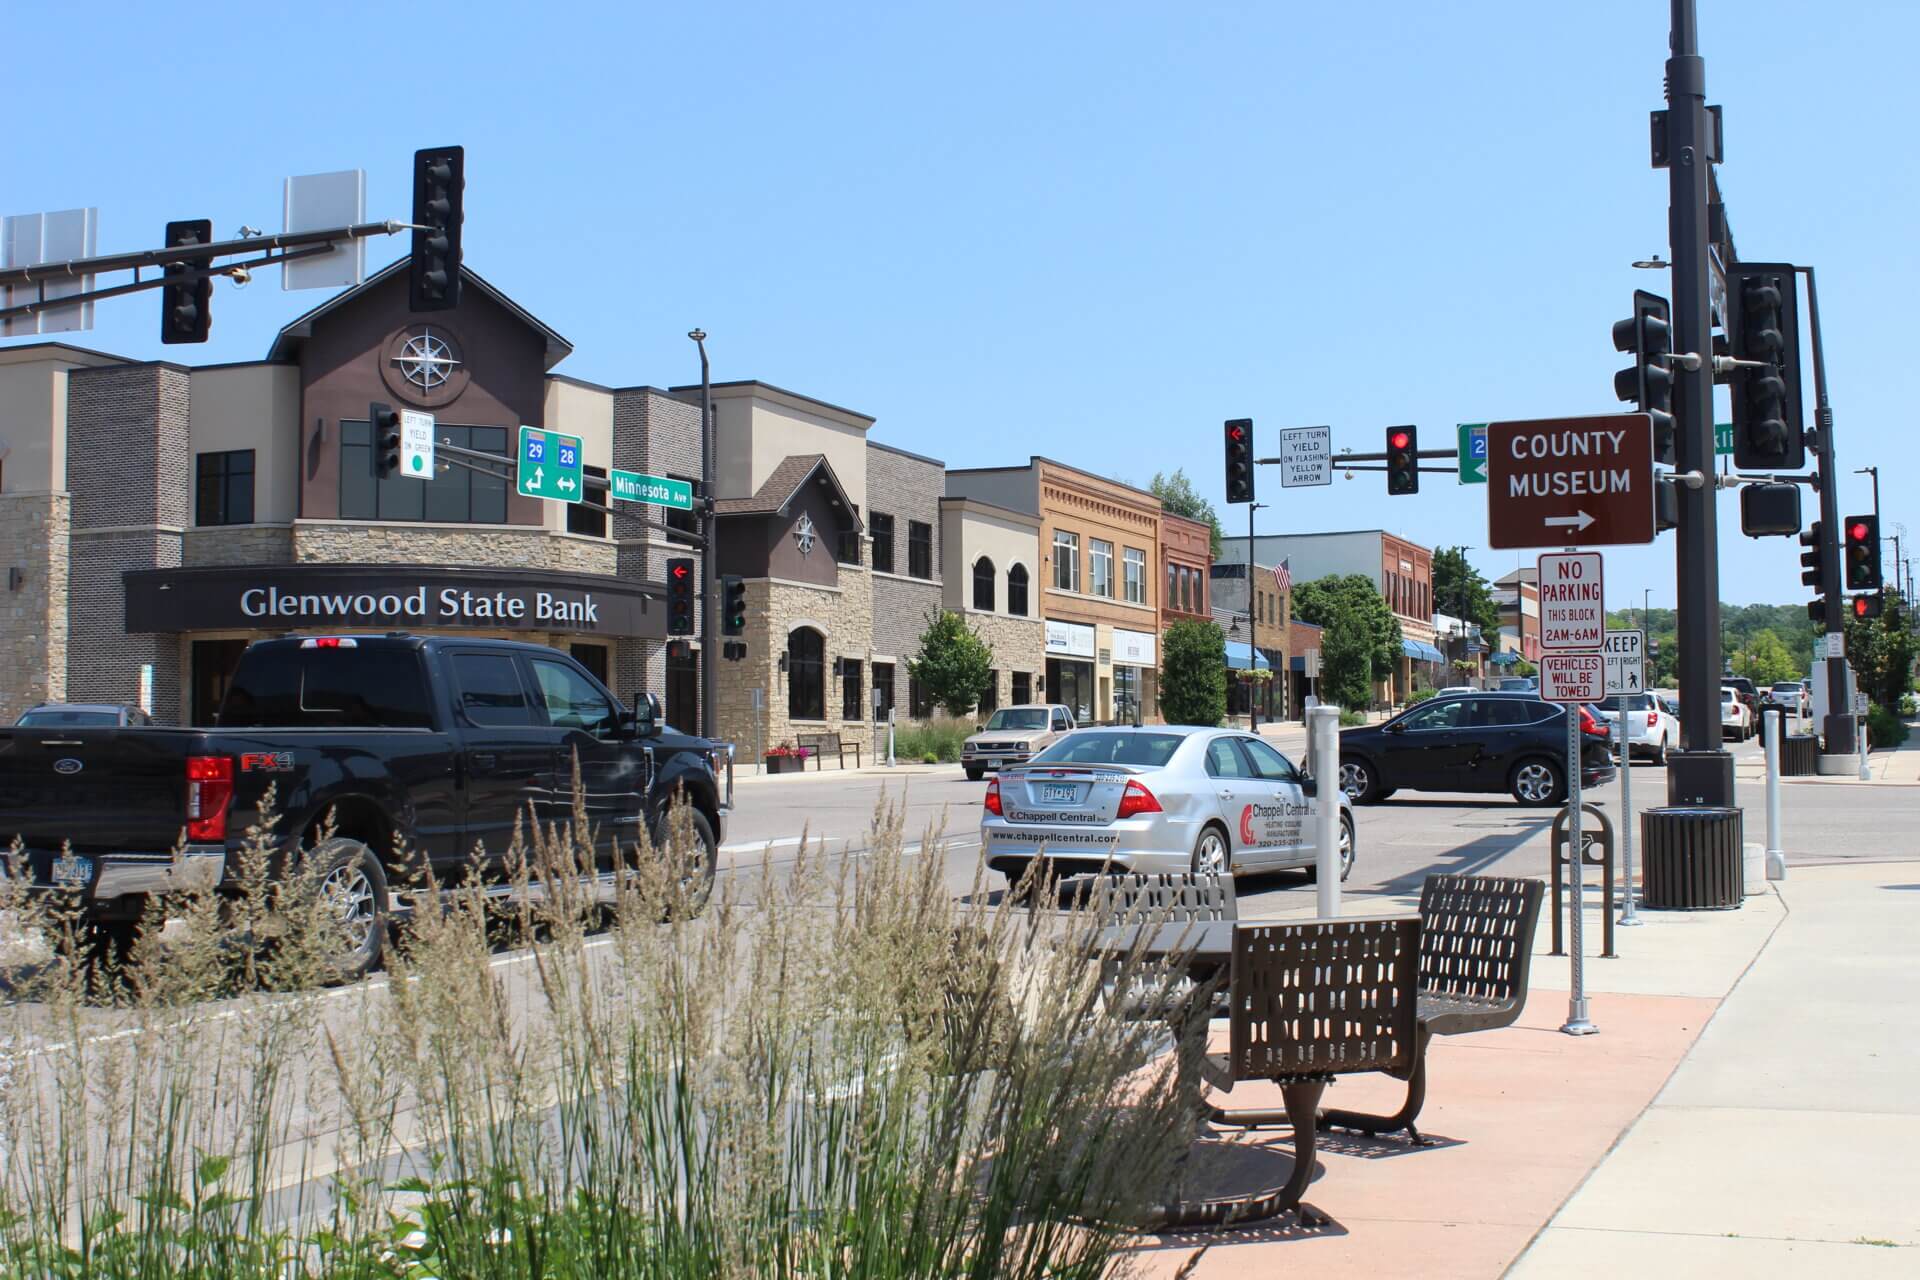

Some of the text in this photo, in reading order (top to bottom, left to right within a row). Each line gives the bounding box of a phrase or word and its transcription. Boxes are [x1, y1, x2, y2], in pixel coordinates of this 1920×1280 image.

[1283, 431, 1328, 441] LEFT TURN
[1292, 442, 1320, 451] YIELD
[1511, 430, 1626, 459] COUNTY
[528, 443, 574, 465] 29 28
[1284, 453, 1329, 463] ON FLASHING
[1291, 464, 1323, 472] YELLOW
[1293, 473, 1321, 482] ARROW
[1509, 468, 1631, 498] MUSEUM
[616, 477, 687, 504] Minnesota Ave
[1558, 561, 1583, 579] NO
[1543, 582, 1600, 602] PARKING
[240, 586, 599, 623] Glenwood State Bank
[1548, 608, 1595, 621] THIS BLOCK
[1546, 629, 1598, 641] 2AM-6AM
[1604, 636, 1639, 653] KEEP
[1546, 658, 1599, 671] VEHICLES
[1607, 656, 1641, 666] EFT RIGHT
[1552, 672, 1593, 684] WILL BE
[1555, 685, 1591, 697] TOWED
[240, 751, 295, 771] FX4
[1016, 811, 1057, 822] Chappell
[1060, 812, 1096, 822] Central
[1253, 803, 1284, 820] Chappell
[1286, 802, 1310, 816] Central
